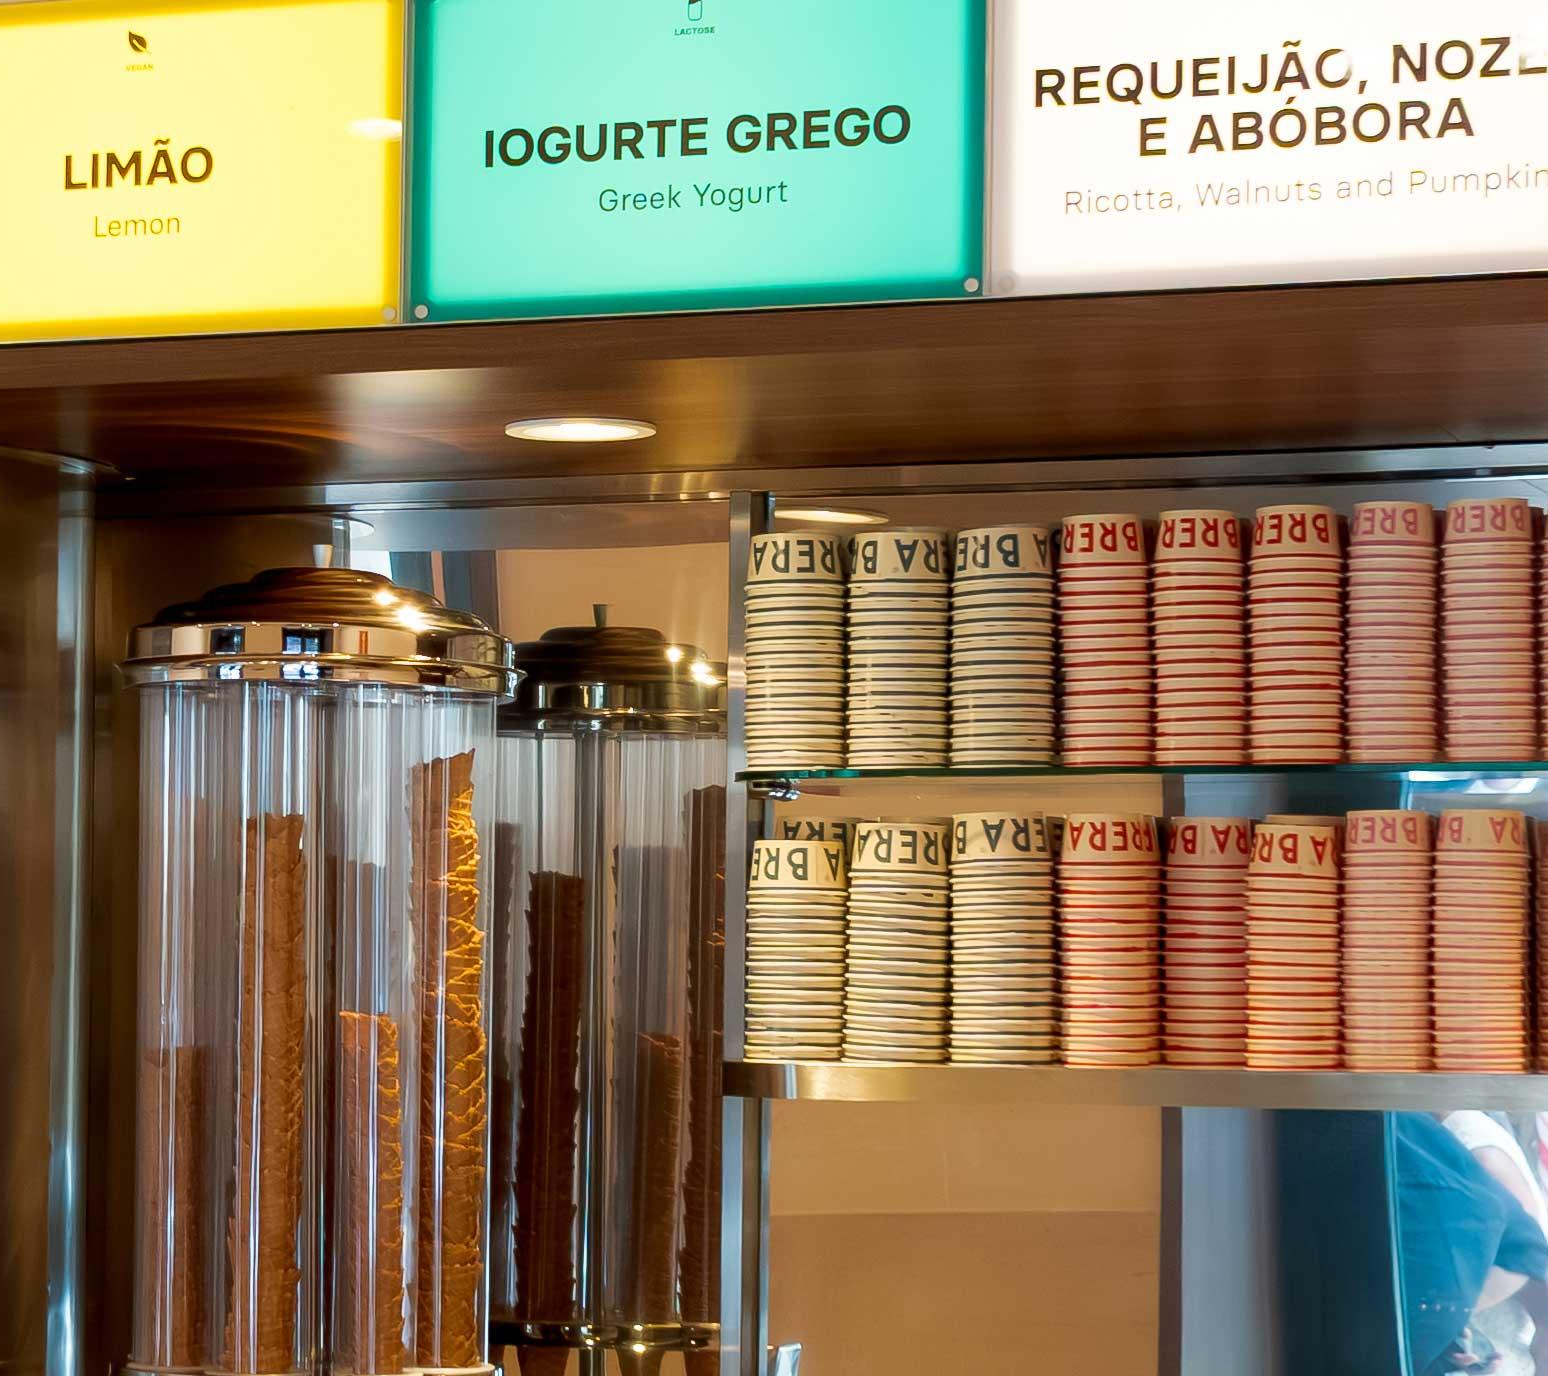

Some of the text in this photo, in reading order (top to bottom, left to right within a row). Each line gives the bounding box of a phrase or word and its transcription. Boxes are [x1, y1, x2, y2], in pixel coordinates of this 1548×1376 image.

[1036, 40, 1370, 107] REQUEIJÃO,
[483, 105, 910, 167] IOGURTE GREGO
[1138, 93, 1474, 156] E ABÓBORA
[62, 139, 212, 189] LIMÃO
[597, 178, 787, 212] Greek Yogurt
[1063, 183, 1180, 214] Ricotta,
[1194, 174, 1324, 206] Walnuts
[1336, 172, 1395, 201] and
[93, 212, 180, 238] Lemon
